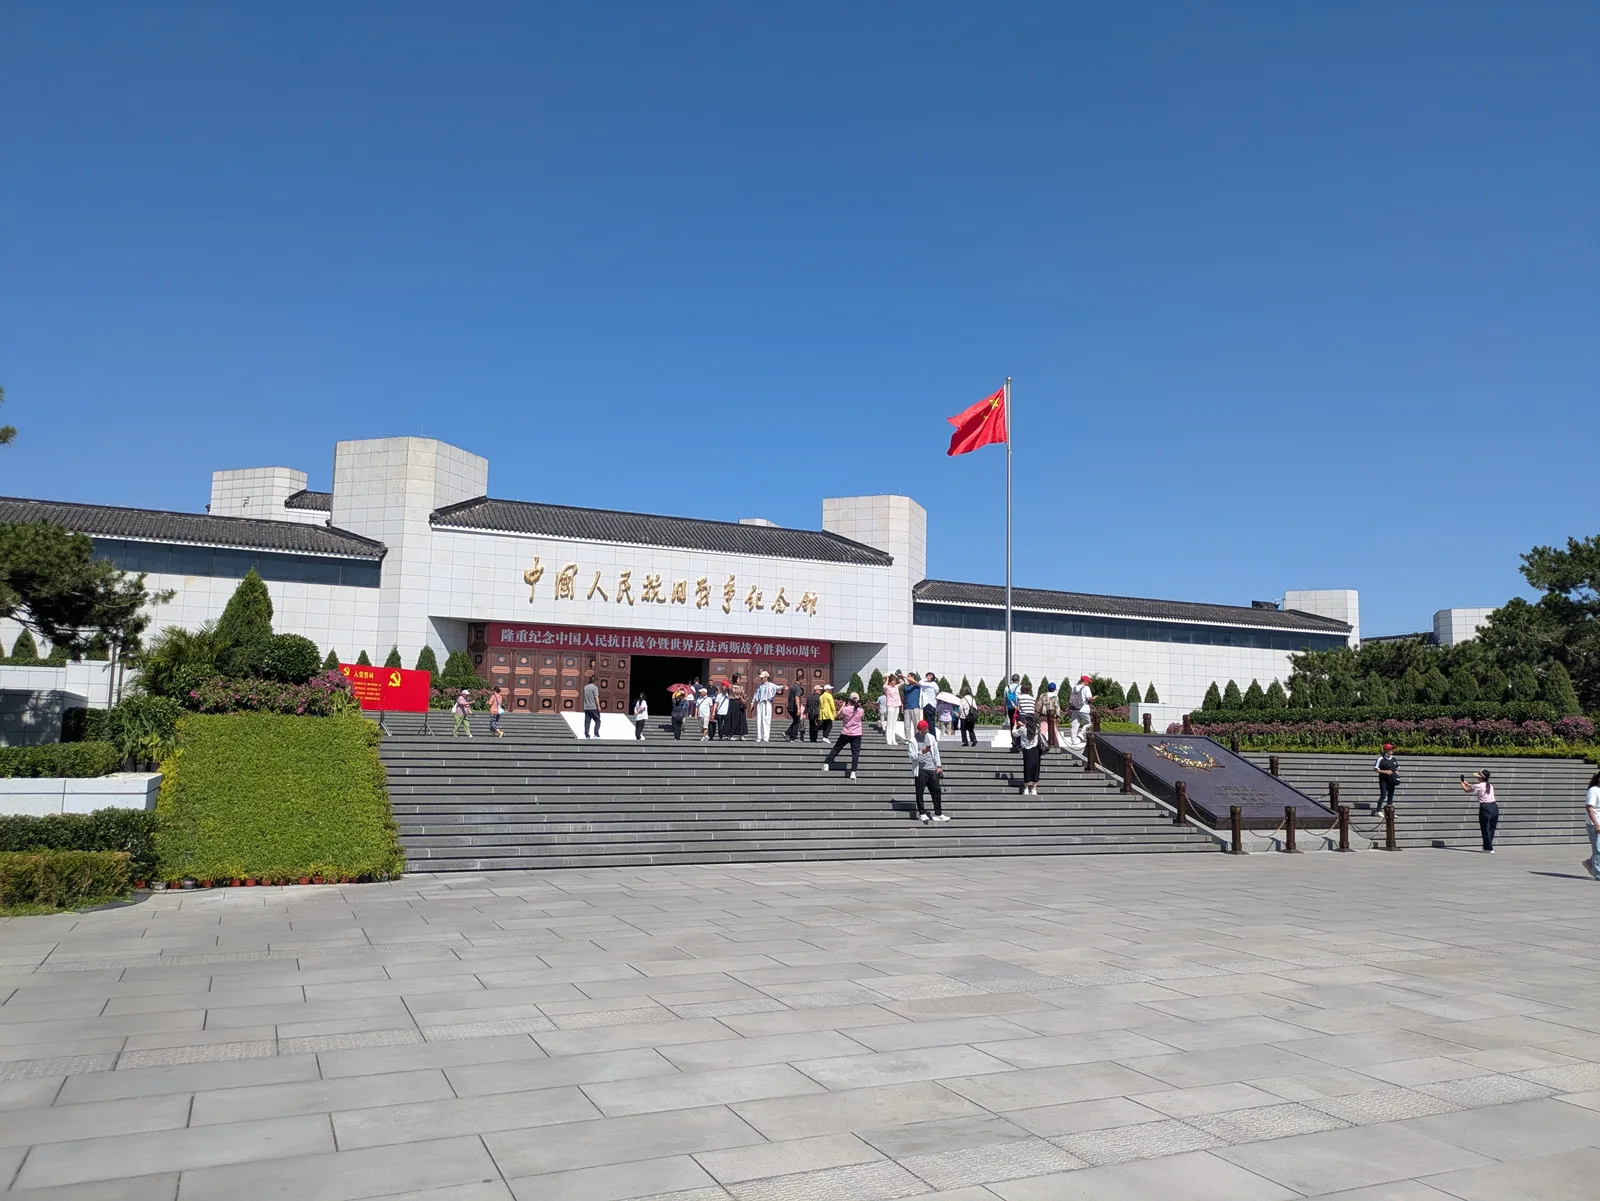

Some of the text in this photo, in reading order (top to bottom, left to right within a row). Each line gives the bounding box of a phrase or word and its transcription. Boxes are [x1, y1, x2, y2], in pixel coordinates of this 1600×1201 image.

[501, 628, 821, 658] 隆重纪念中国人民抗日战争暨世界反法西斯战争胜利80周年
